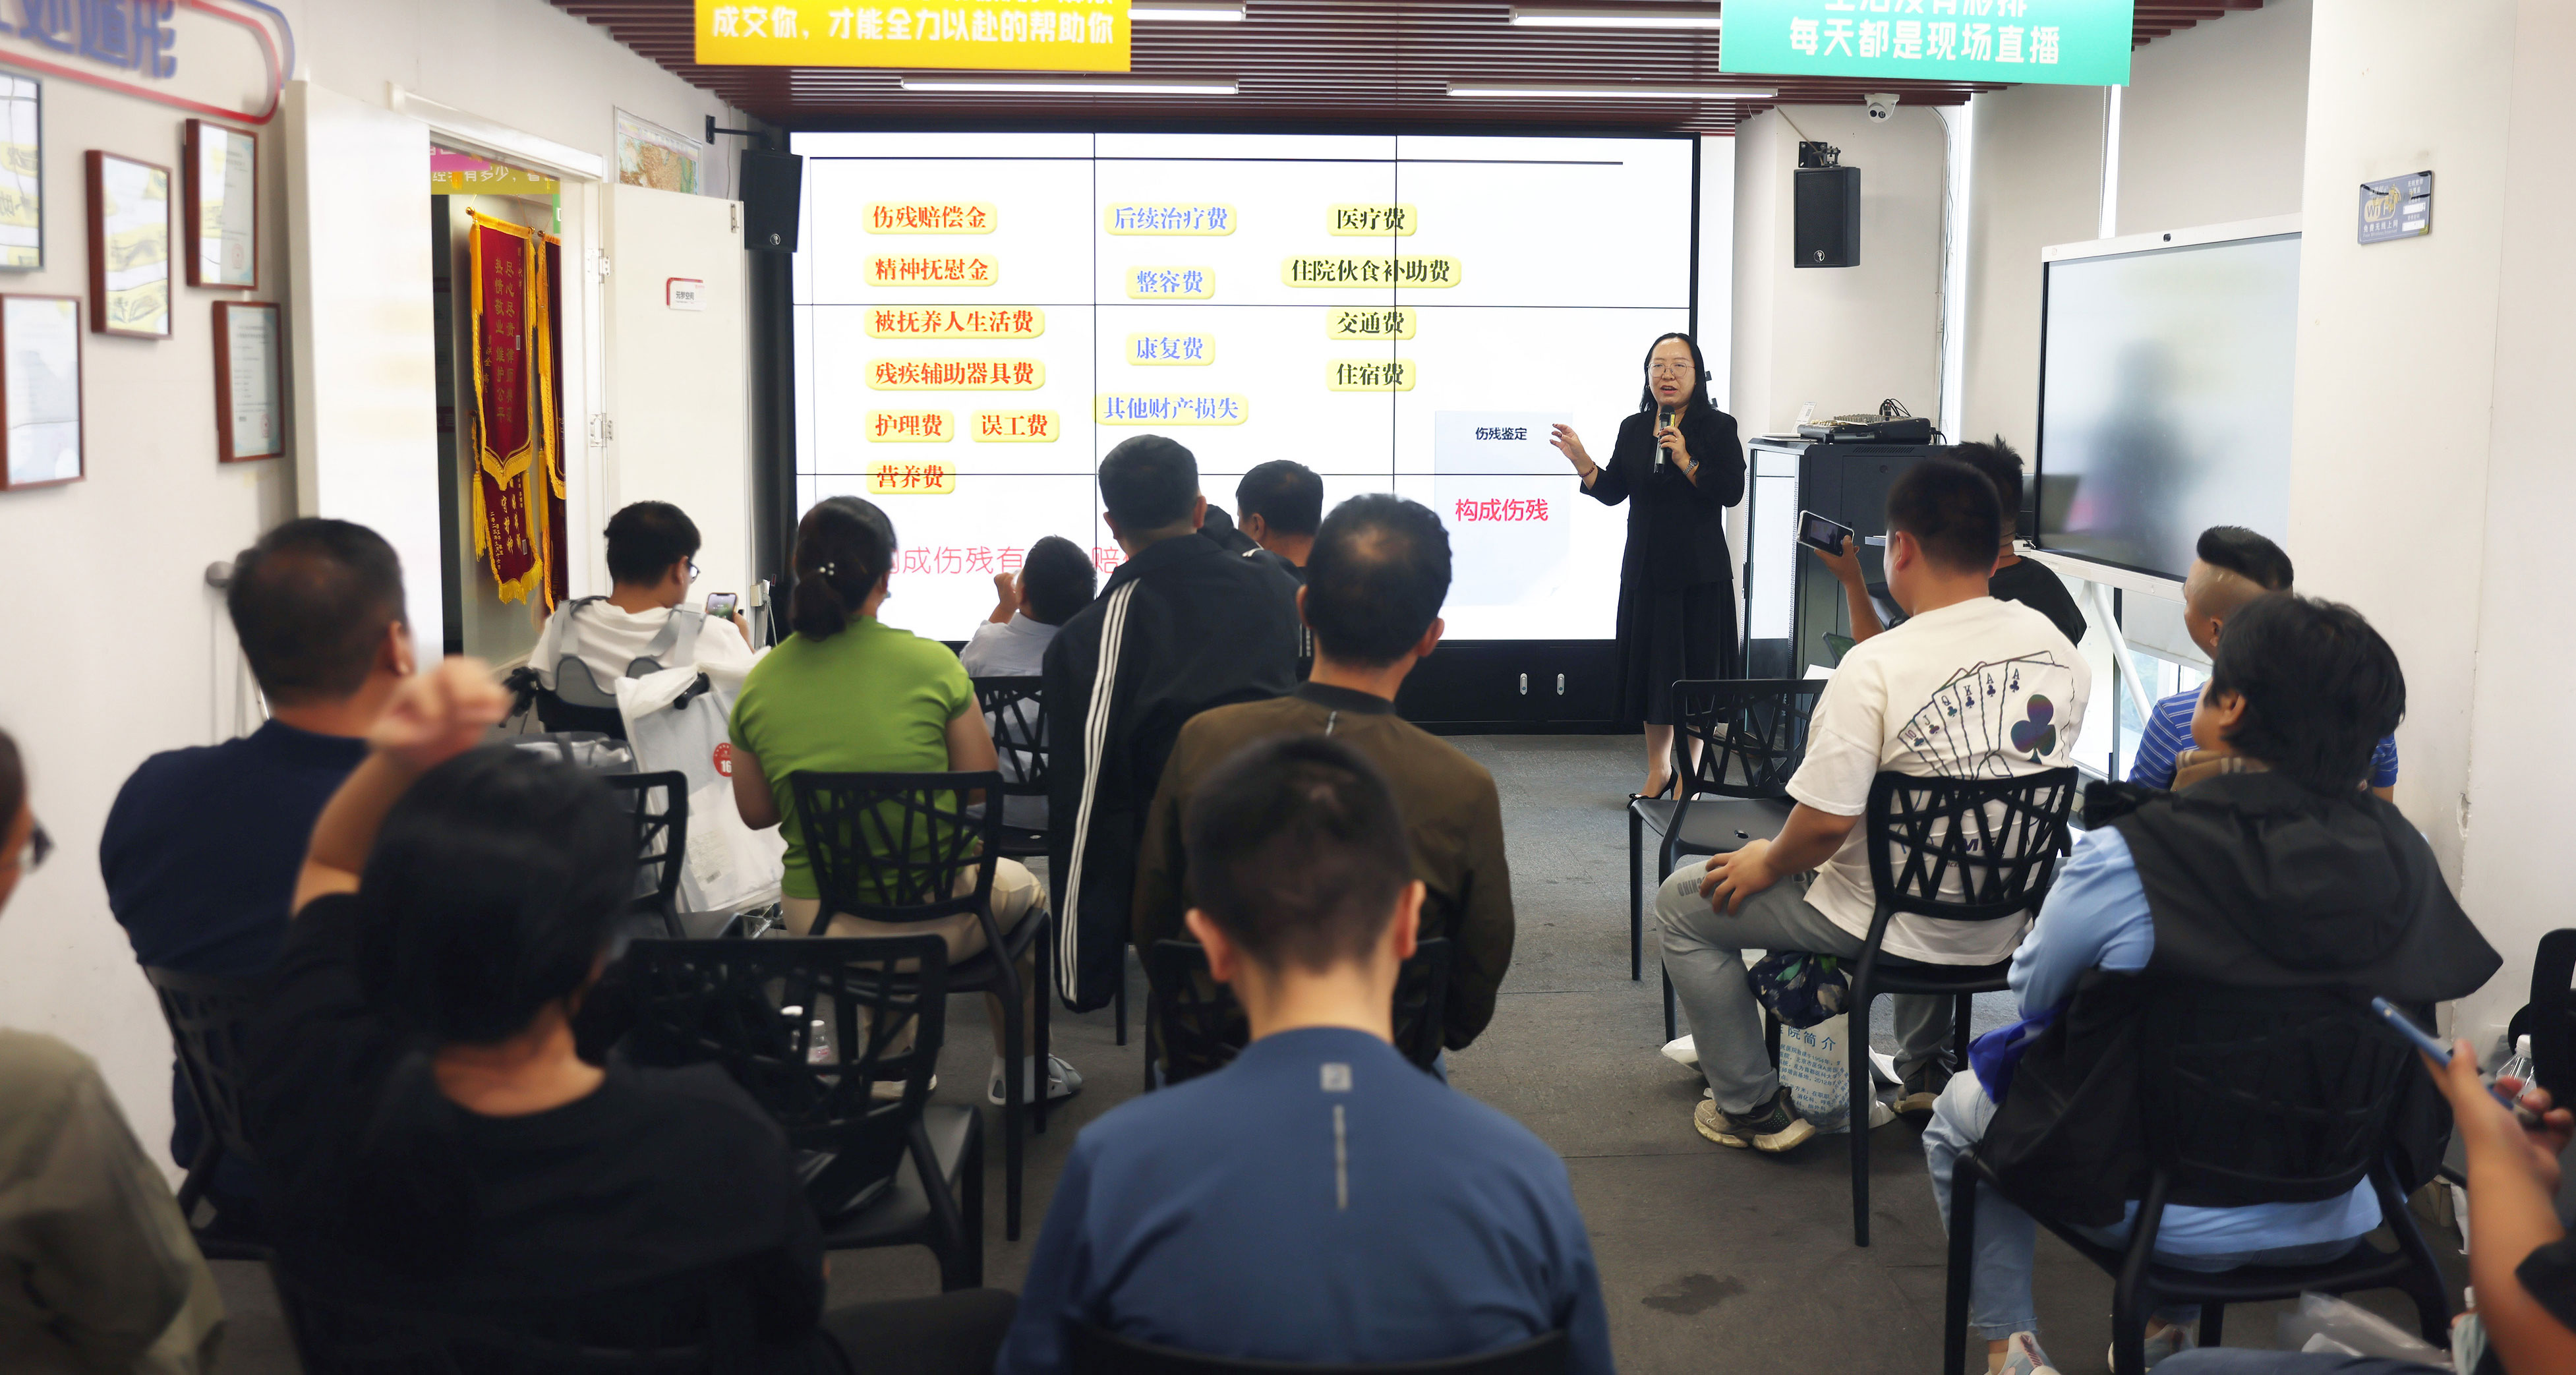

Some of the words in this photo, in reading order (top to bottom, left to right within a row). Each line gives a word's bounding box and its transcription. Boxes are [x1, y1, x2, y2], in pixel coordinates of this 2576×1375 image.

[713, 6, 1114, 44] 成交你，才能全力以赴的帮助你
[1789, 17, 2061, 65] 每天都是现场直播
[873, 206, 986, 228] 伤残赔偿金
[1115, 207, 1228, 230] 后续治疗费
[1337, 208, 1405, 230] 医疗费
[2367, 205, 2379, 218] Wi
[875, 258, 988, 280] 精神抚慰金
[1293, 260, 1450, 282] 住院伙食补助费
[1136, 270, 1204, 293] 整容费
[505, 260, 515, 337] 尽心尽责
[875, 310, 1034, 333] 被抚养人生活费
[1338, 312, 1405, 334] 交通费
[1136, 337, 1204, 359] 康复费
[875, 362, 1034, 385] 残疾辅助器具费
[1337, 363, 1404, 386] 住宿费
[1104, 397, 1239, 420] 其他财产损失
[875, 414, 943, 436] 护理费
[981, 414, 1048, 436] 误工费
[1475, 427, 1527, 441] 伤残鉴定
[877, 465, 944, 488] 营养费
[1455, 498, 1549, 522] 构成伤残
[1986, 672, 1995, 685] A
[2011, 668, 2020, 680] A
[1780, 1024, 1836, 1051] 院简介
